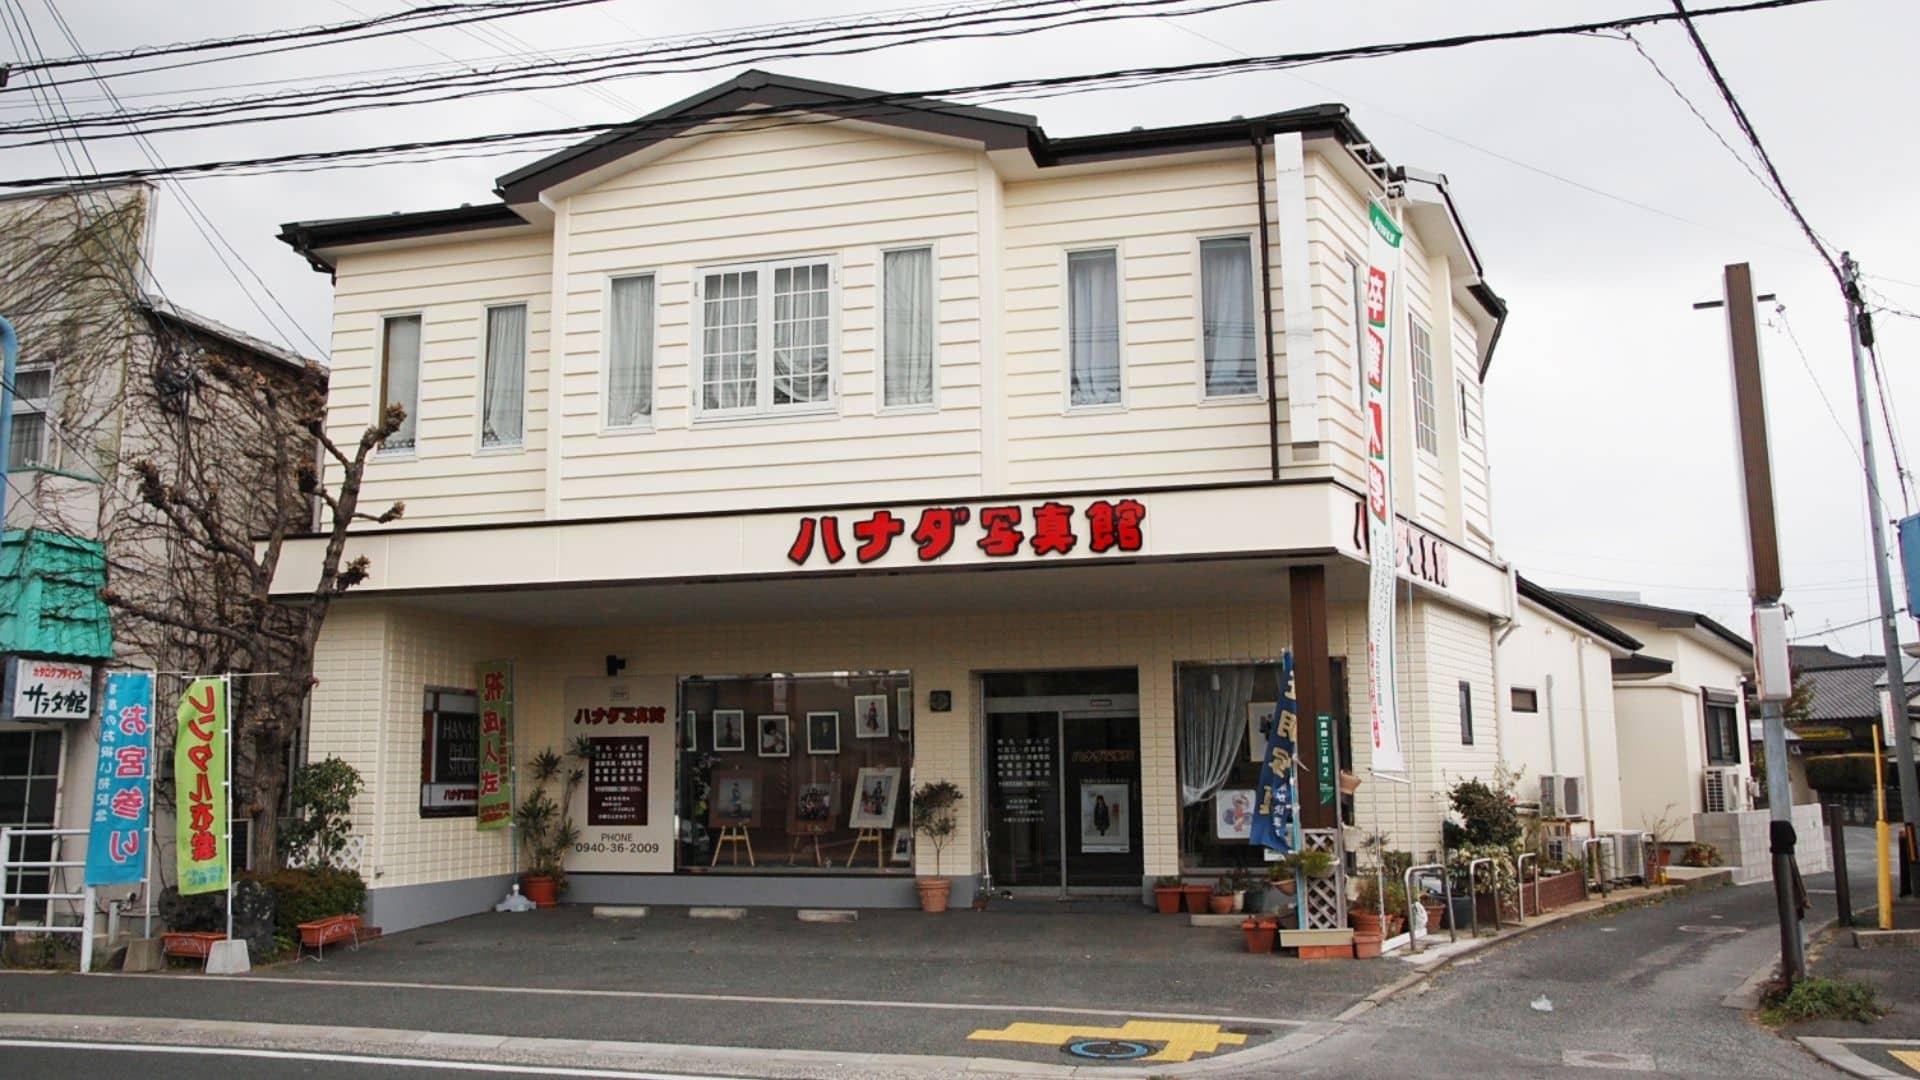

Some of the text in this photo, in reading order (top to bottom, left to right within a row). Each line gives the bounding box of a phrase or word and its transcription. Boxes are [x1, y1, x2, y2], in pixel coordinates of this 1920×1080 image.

[787, 499, 1146, 566] ハナダ写真館
[600, 832, 633, 843] PHONE
[574, 842, 660, 854] 0940-36-2009
